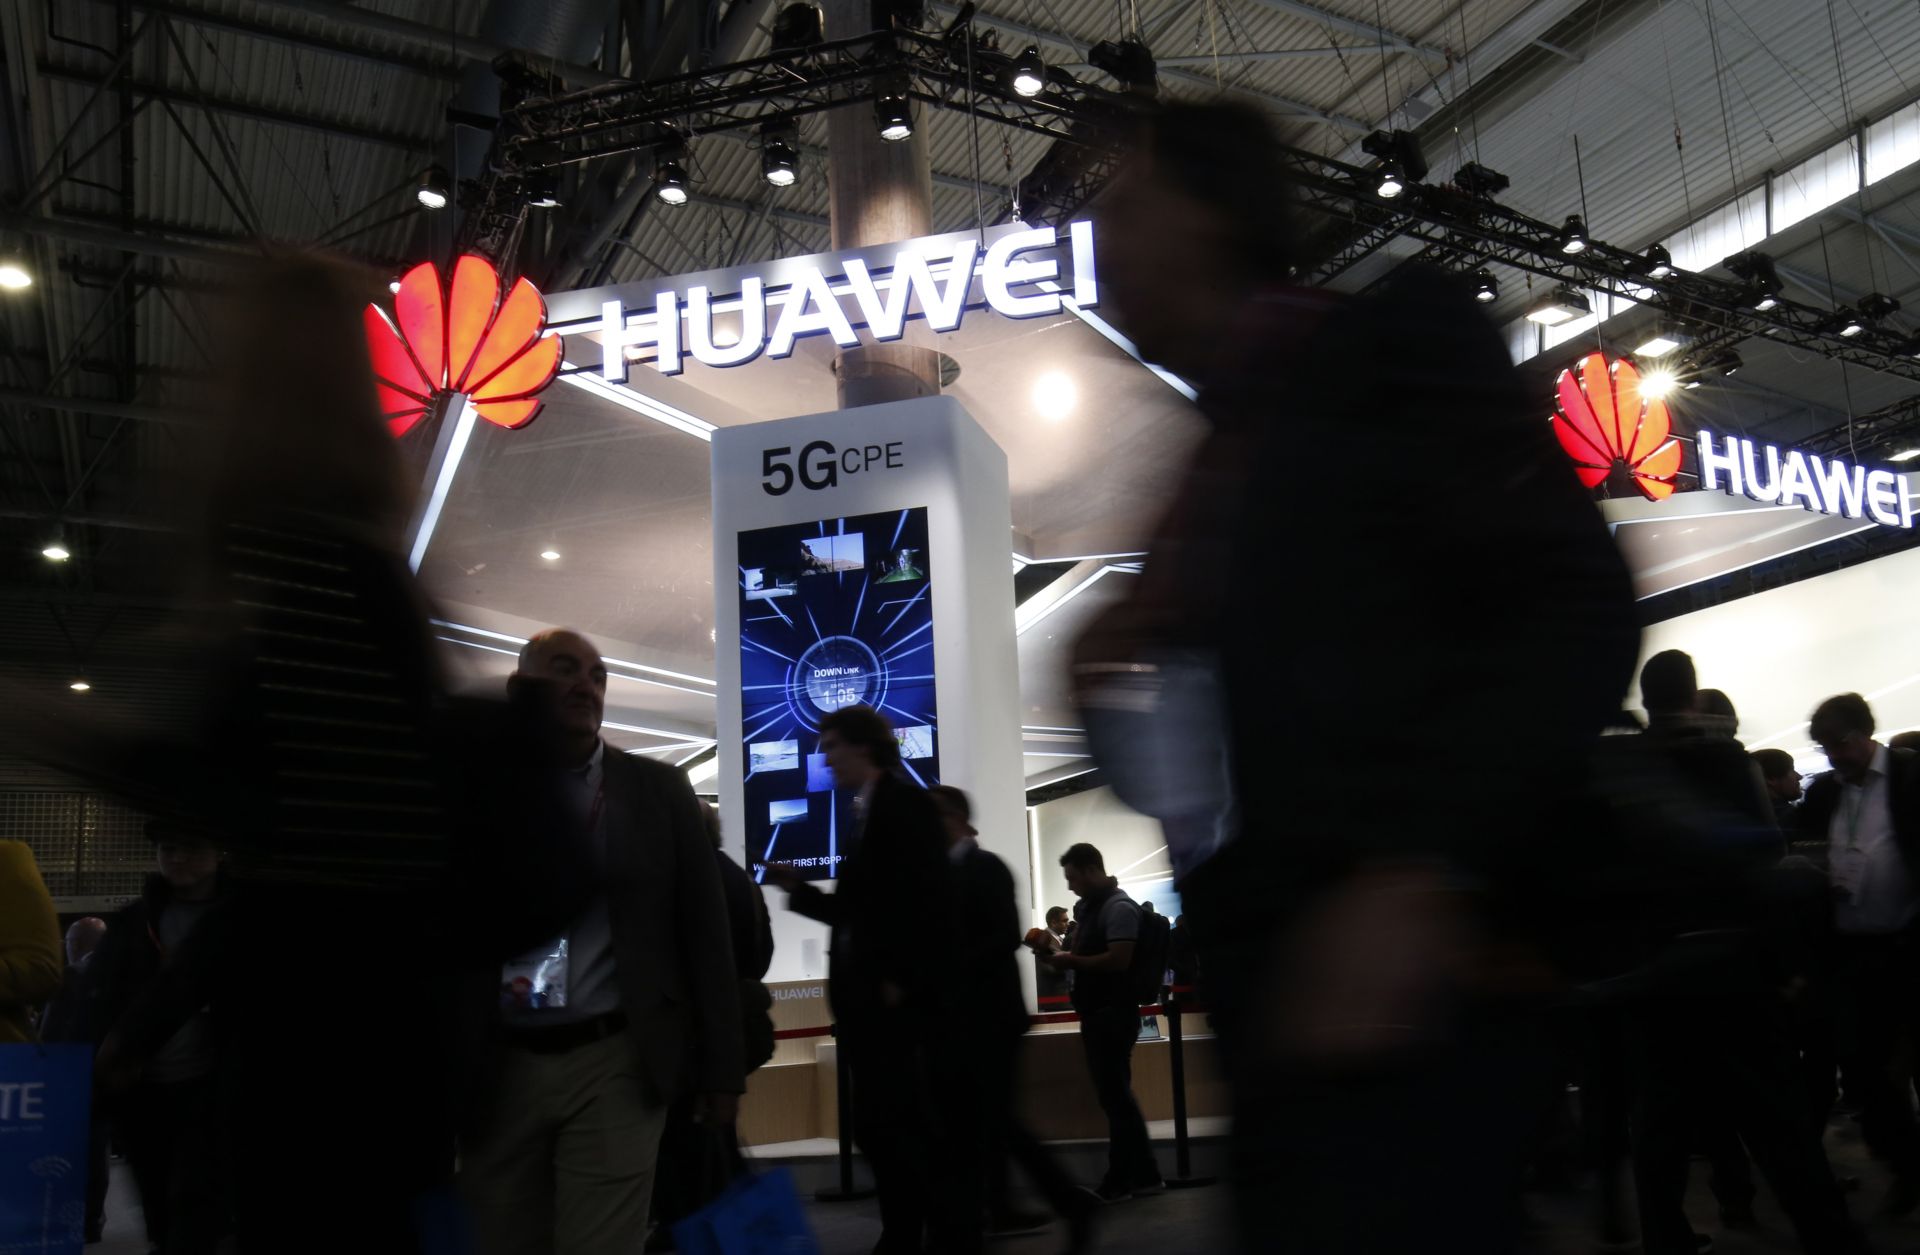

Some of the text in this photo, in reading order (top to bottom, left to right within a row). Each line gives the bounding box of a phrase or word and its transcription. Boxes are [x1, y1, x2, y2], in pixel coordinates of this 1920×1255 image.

[601, 220, 1098, 383] HUAWEI
[762, 440, 903, 496] 5G CPE
[1696, 430, 1913, 529] HUAWEI
[814, 667, 860, 678] DOWN LINK
[823, 688, 856, 704] 1.05
[792, 857, 818, 868] FIRST
[818, 855, 842, 866] 3GPP
